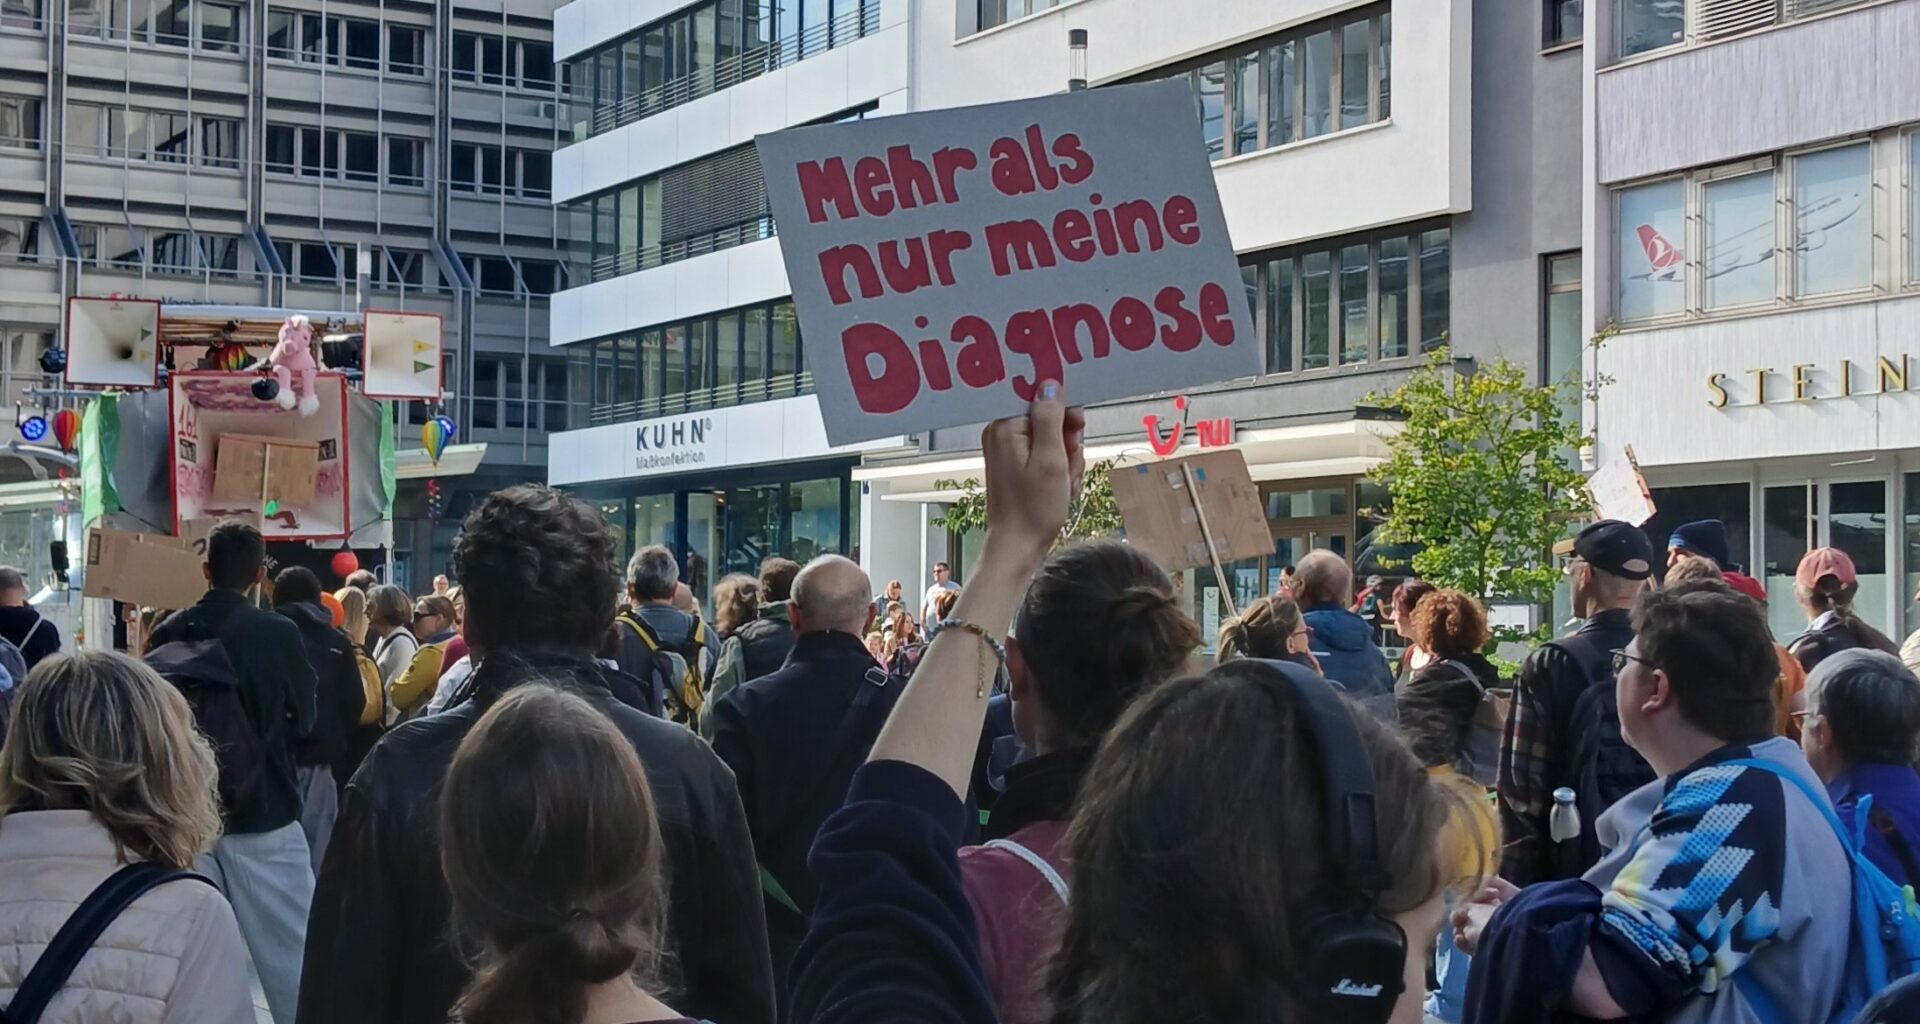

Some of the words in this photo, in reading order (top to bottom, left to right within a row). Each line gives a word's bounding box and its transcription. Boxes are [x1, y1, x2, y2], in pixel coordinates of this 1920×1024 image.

[796, 144, 978, 224] Mehr
[988, 123, 1094, 197] als
[817, 229, 972, 305] nur
[984, 193, 1201, 277] meine
[841, 282, 1236, 414] Diagnose
[1706, 353, 1909, 409] STEIN
[1196, 417, 1231, 448] TUI
